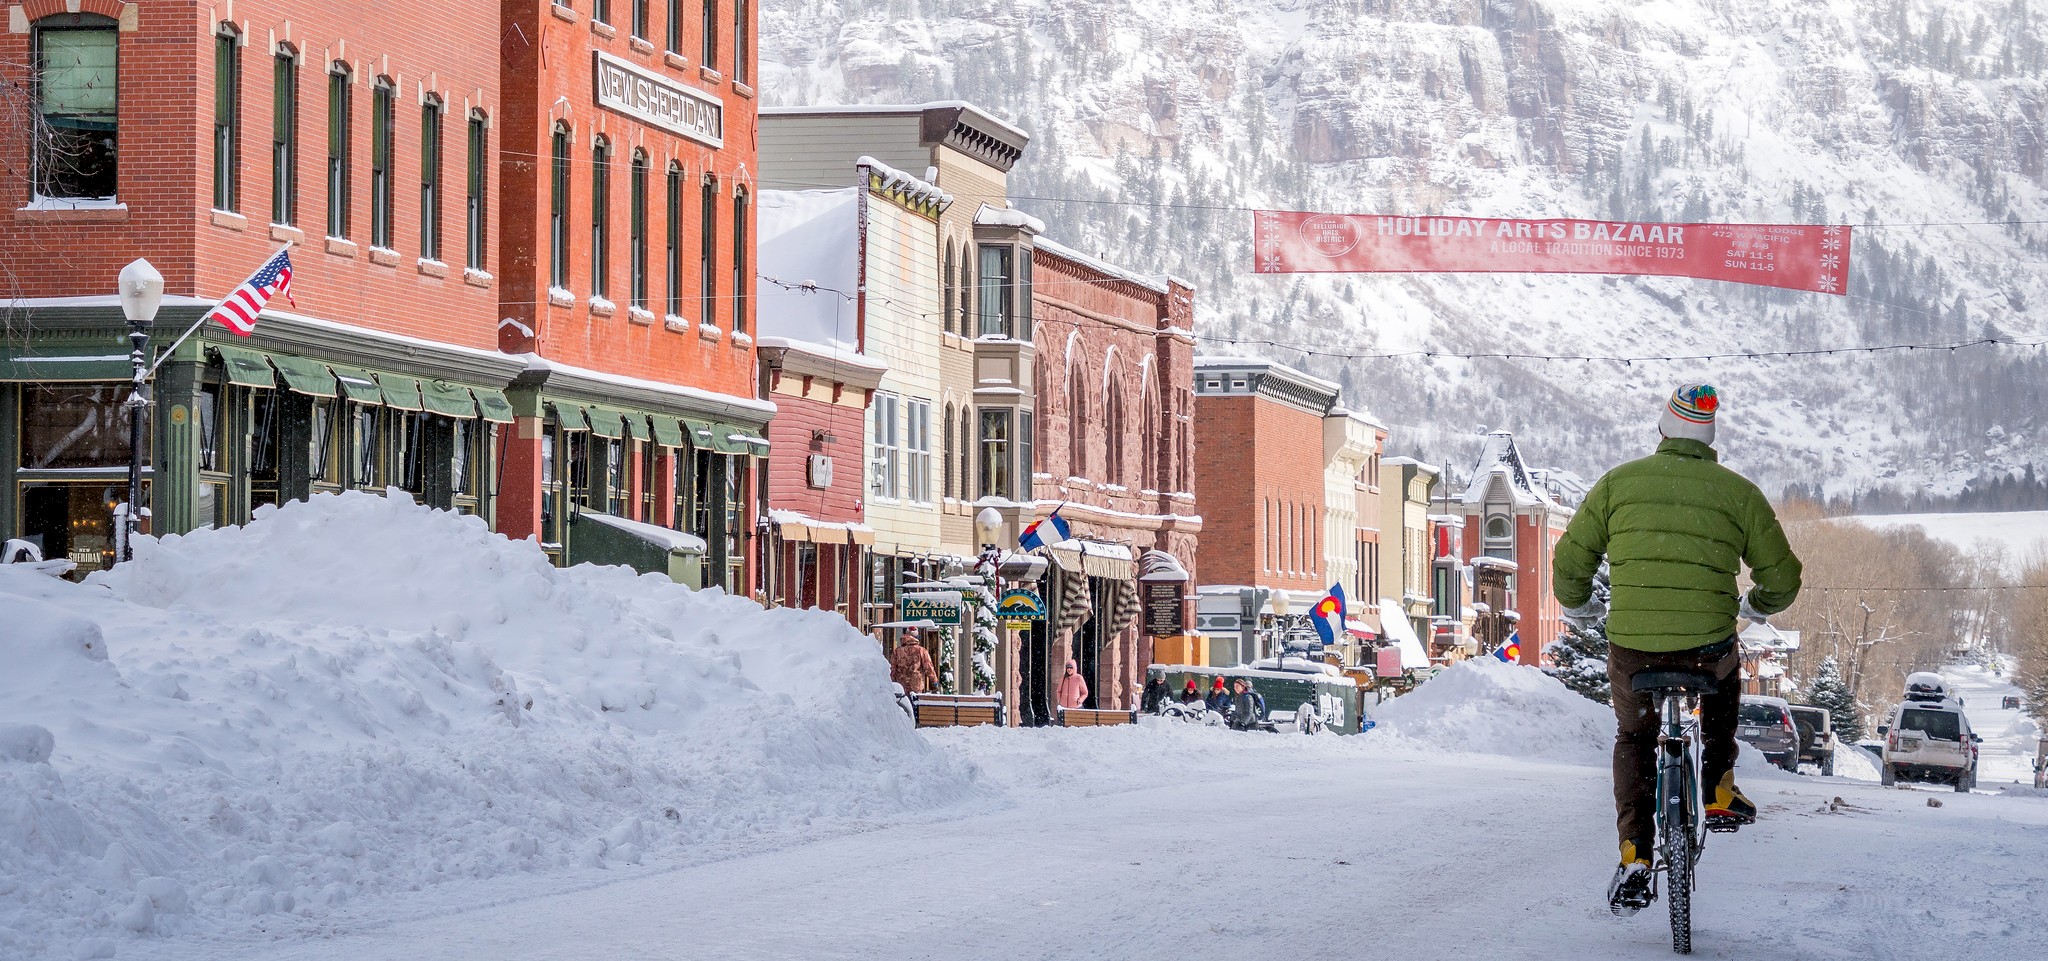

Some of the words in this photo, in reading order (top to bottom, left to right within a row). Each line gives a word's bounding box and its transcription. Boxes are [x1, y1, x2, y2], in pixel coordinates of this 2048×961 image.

[600, 62, 633, 106] NEW
[637, 78, 716, 138] SHERIDAN
[1377, 216, 1488, 237] HOLIDAY
[1496, 220, 1567, 240] ARTS
[1574, 222, 1684, 244] BAZAAR
[1769, 227, 1804, 236] LODGE
[1751, 233, 1790, 244] PACIFIC
[1490, 240, 1499, 253] A
[1502, 240, 1542, 254] LOCAL
[1545, 242, 1613, 256] TRADITION
[1615, 244, 1653, 258] SINCE
[1656, 246, 1685, 259] 1973
[1731, 240, 1748, 249] FRI
[1726, 249, 1746, 258] SAT
[1750, 252, 1774, 260] 11-5
[1725, 259, 1747, 269] SUN
[1750, 262, 1774, 271] 11-5
[68, 552, 101, 563] SHERIDAN
[906, 609, 928, 617] FINE
[931, 609, 957, 617] RUGS
